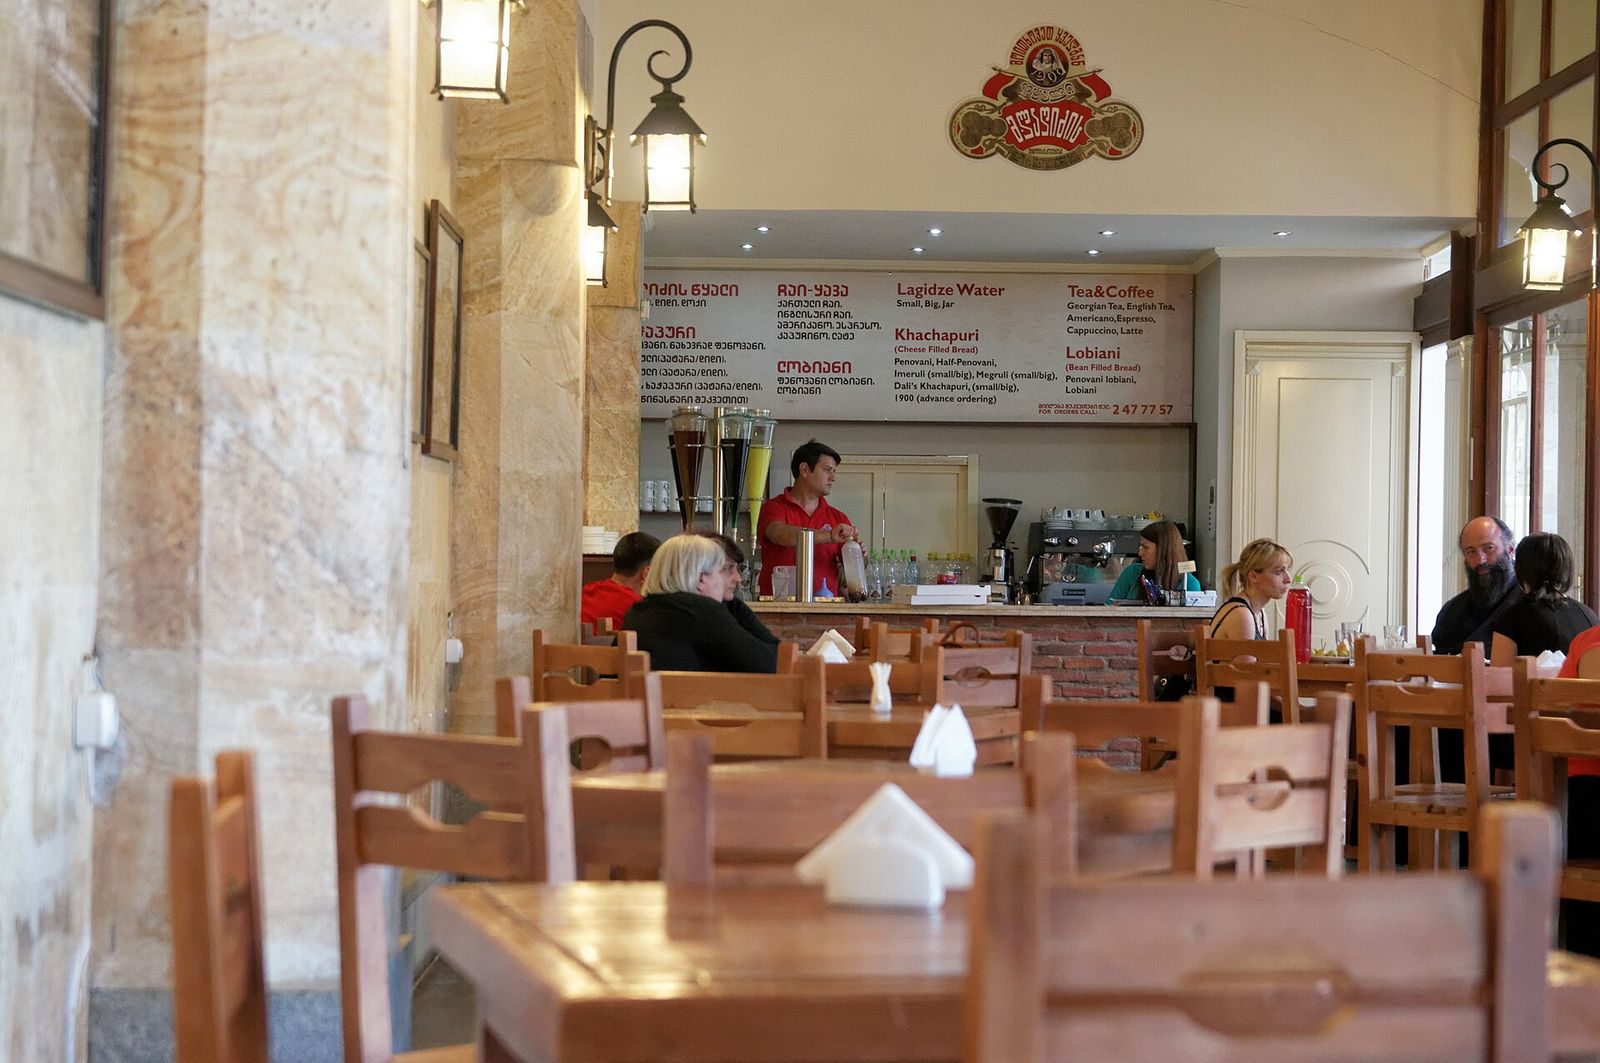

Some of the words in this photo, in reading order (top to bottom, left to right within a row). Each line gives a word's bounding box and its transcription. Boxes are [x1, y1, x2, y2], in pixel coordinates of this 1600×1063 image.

[643, 283, 687, 296] იძის
[691, 283, 739, 296] წყალი
[777, 284, 849, 297] ჩაი-ყავა
[897, 283, 954, 299] Lagidze
[956, 283, 1005, 296] Water
[1067, 285, 1154, 298] Tea&Coffee
[681, 299, 707, 307] დოქი
[777, 300, 821, 308] ქართული
[896, 299, 923, 308] Small,
[924, 300, 941, 309] Big,
[941, 300, 955, 309] Jar
[1067, 302, 1106, 312] Georgian
[1108, 302, 1125, 311] Tea,
[1127, 302, 1157, 312] English
[1158, 303, 1176, 311] Tea,
[777, 310, 832, 318] ინგლისური
[641, 326, 696, 338] აპური
[832, 332, 855, 340] ლატე
[895, 328, 979, 344] Khachapuri
[1066, 326, 1119, 336] Cappuccino,
[1120, 327, 1143, 335] Latte
[669, 341, 713, 350] ნახევრად
[894, 346, 926, 355] (Cheese
[951, 346, 979, 355] Bread)
[1066, 346, 1120, 359] Lobiani
[777, 361, 852, 374] ლობიანი
[894, 358, 934, 367] Penovani,
[936, 358, 997, 367] Half-Penovani,
[1065, 363, 1089, 372] (Bean
[1114, 364, 1141, 373] Bread)
[777, 376, 827, 385] ფენოვანი
[894, 370, 925, 378] Imeruli
[927, 370, 975, 380] (small/big),
[976, 371, 1009, 381] Megruli
[1010, 371, 1058, 381] (small/big),
[1065, 375, 1104, 383] Penovani
[1105, 376, 1137, 384] lobiani,
[645, 382, 693, 390] ხაჭაპური
[777, 386, 822, 395] ლობიანი
[894, 382, 918, 390] Dali's
[920, 382, 971, 393] Khachapuri,
[972, 383, 1019, 393] (small/big),
[1065, 386, 1097, 394] Lobiani
[894, 394, 914, 402] 1900
[916, 394, 954, 403] (advance
[956, 395, 997, 404] ordering)
[1113, 404, 1120, 415] 2
[1122, 404, 1138, 415] 47
[1141, 404, 1156, 415] 77
[1159, 404, 1174, 415] 57
